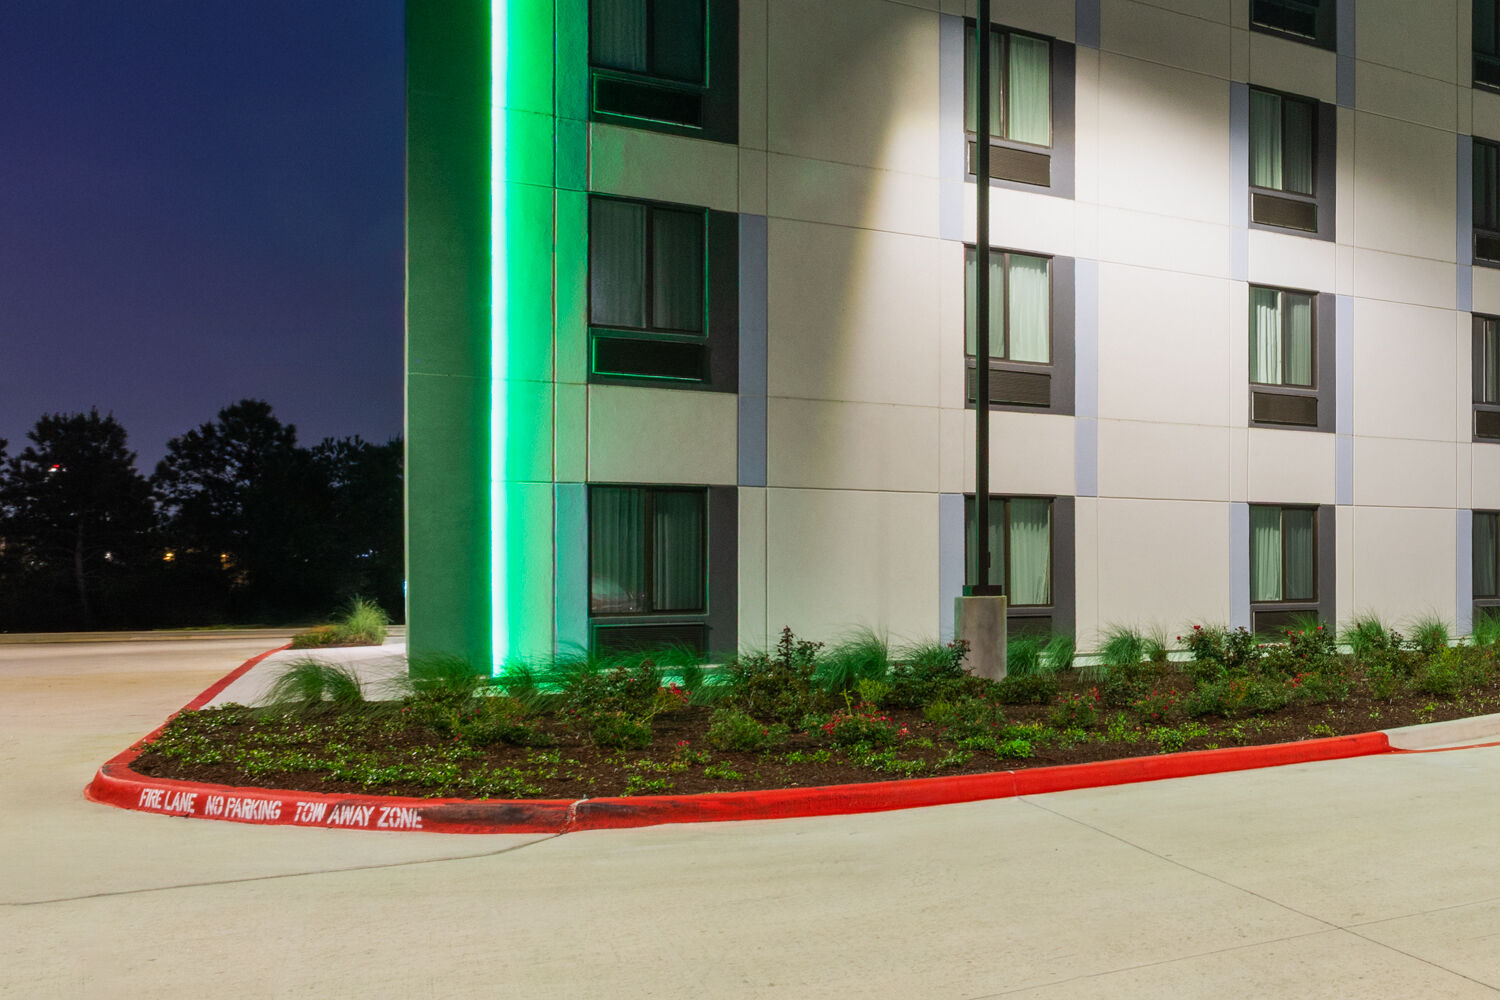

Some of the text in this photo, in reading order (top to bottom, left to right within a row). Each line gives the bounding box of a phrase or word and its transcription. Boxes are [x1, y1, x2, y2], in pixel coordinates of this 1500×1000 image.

[138, 788, 424, 829] FIRE LANE NO PARKING TOW AWAY ZONE
